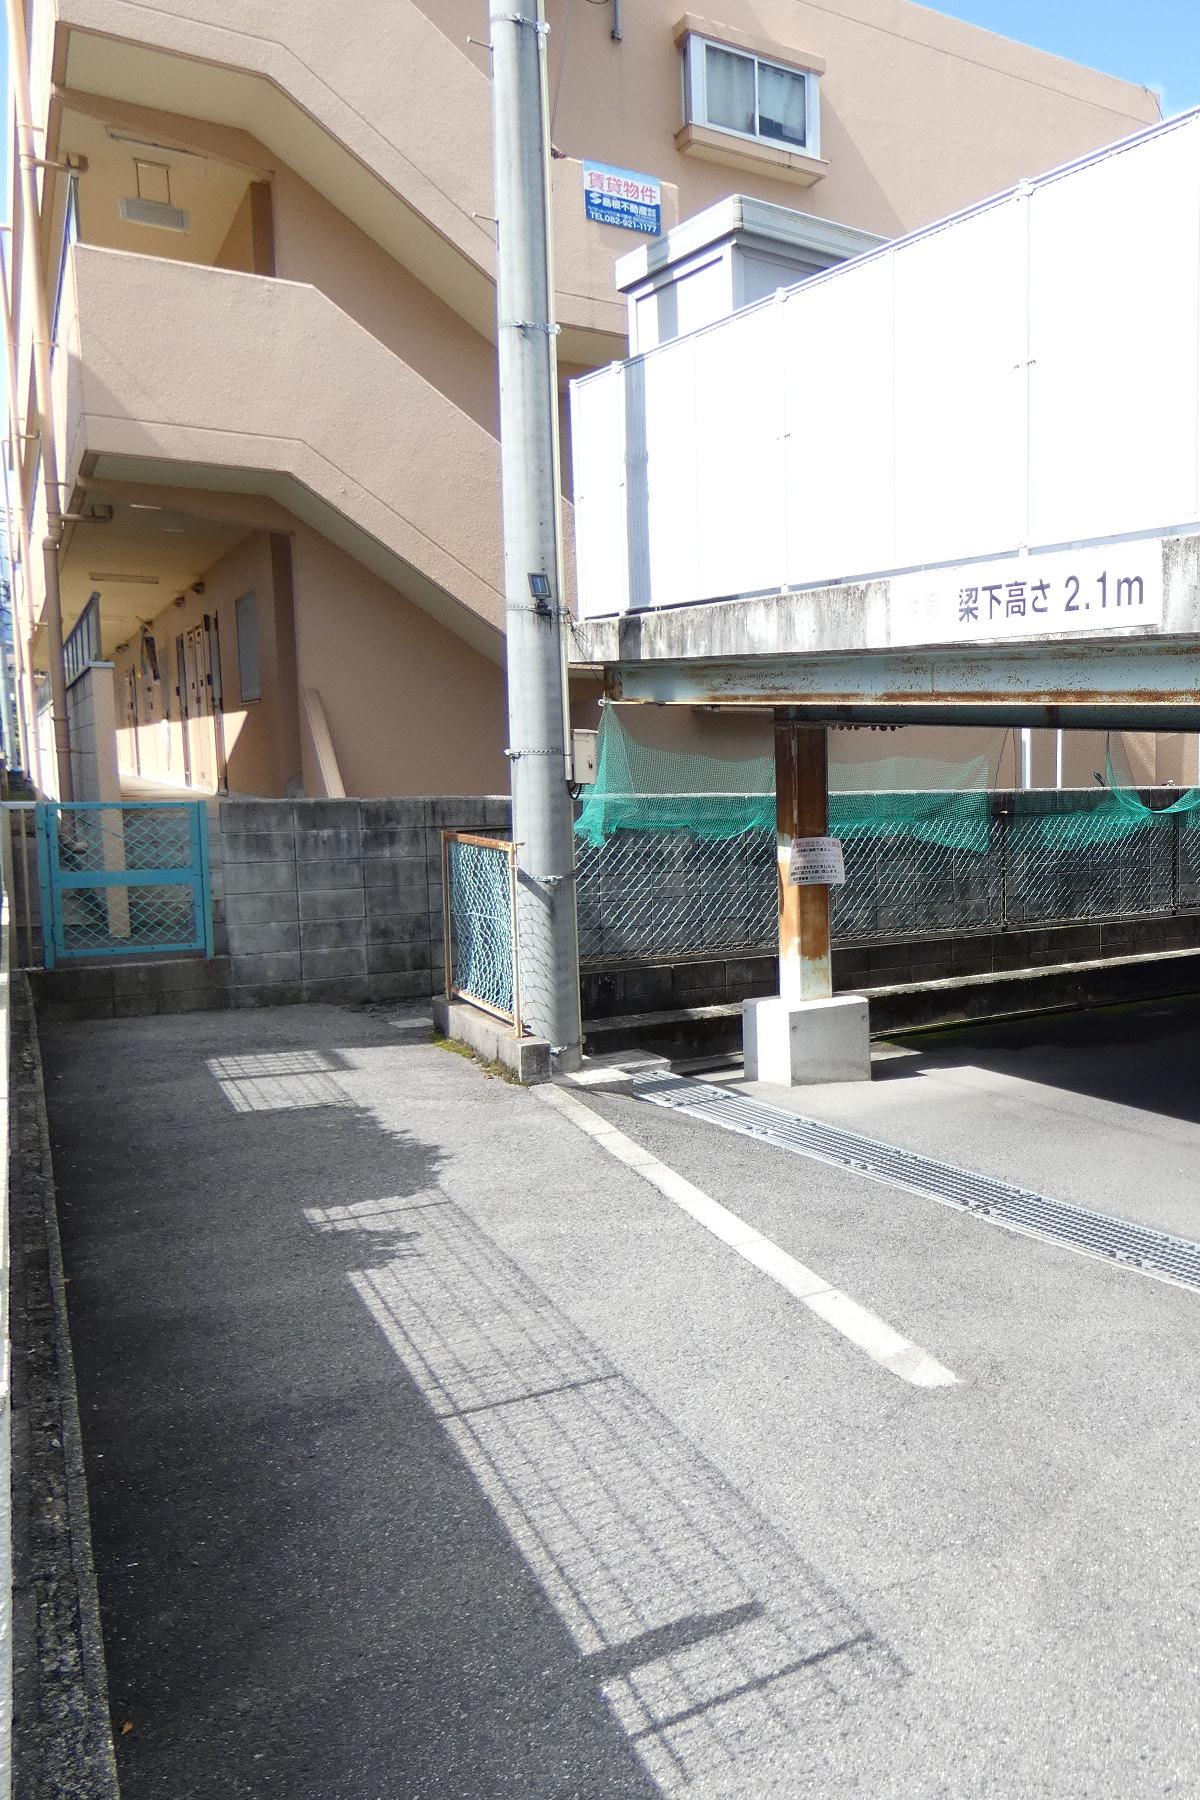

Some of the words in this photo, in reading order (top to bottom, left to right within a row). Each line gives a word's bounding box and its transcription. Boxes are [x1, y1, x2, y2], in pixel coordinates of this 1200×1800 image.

[959, 578, 1051, 622] 梁下高さ
[1064, 570, 1144, 612] 2.1m
